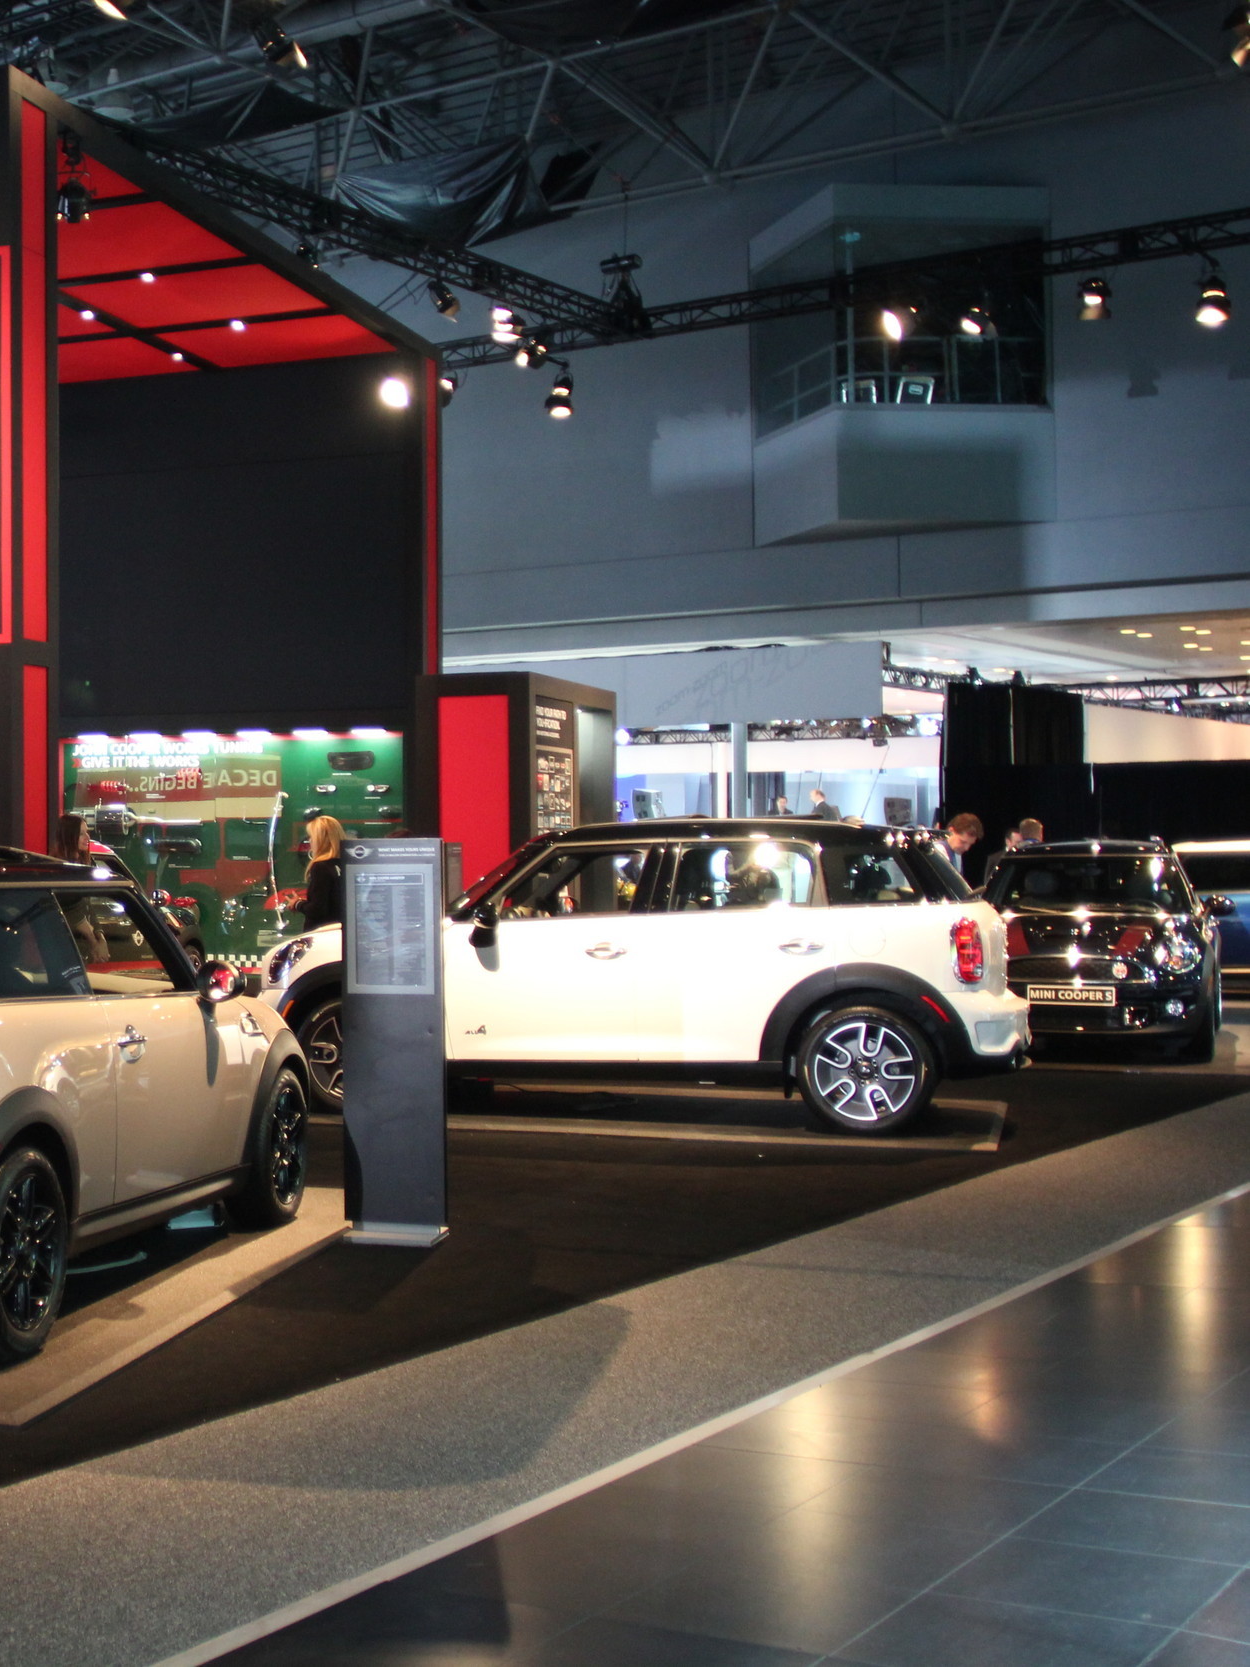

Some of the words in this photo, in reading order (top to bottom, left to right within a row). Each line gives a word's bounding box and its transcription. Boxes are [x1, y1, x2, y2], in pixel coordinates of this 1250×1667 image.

[82, 756, 110, 768] GIVE
[113, 756, 124, 767] IT
[126, 756, 150, 767] THE
[153, 755, 199, 767] WORKS
[1030, 990, 1055, 999] MINI
[1058, 990, 1103, 1000] COOPER
[1105, 992, 1112, 1000] S
